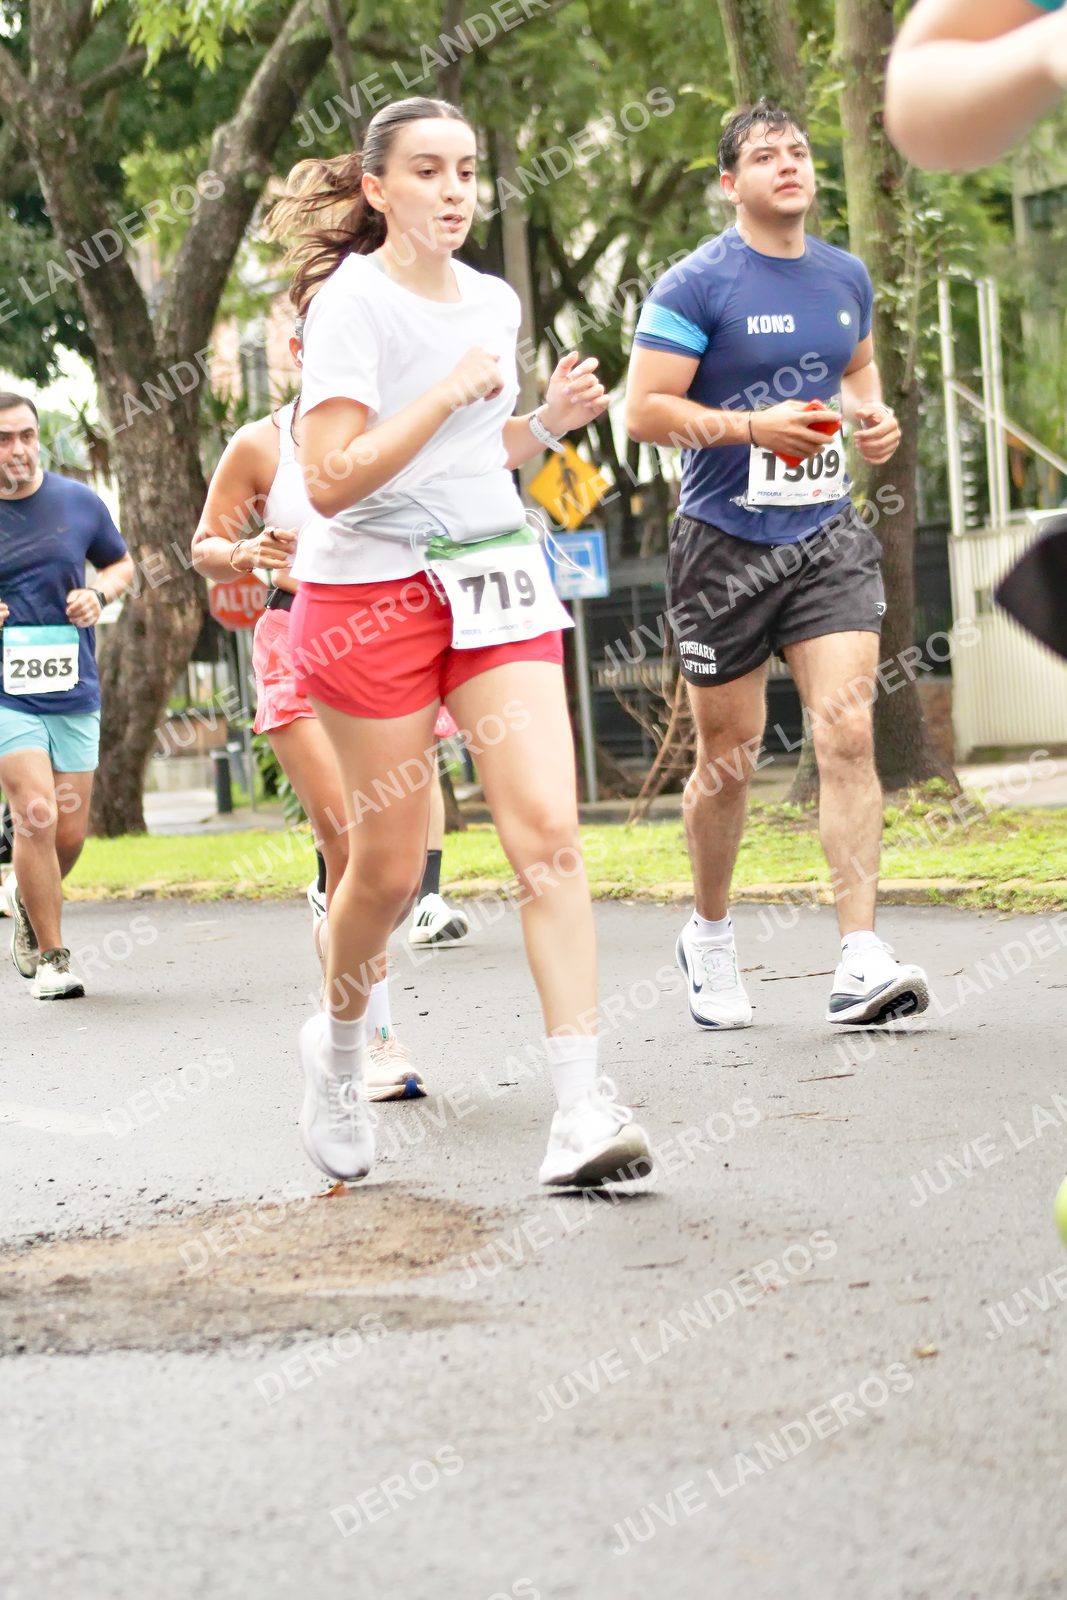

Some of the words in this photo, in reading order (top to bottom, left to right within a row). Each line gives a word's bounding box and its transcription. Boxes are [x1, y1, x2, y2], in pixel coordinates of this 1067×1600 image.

[746, 314, 796, 335] KON3
[215, 584, 265, 613] ALTO
[457, 569, 536, 615] 719
[9, 657, 73, 679] 2863
[682, 658, 718, 675] LIFTING
